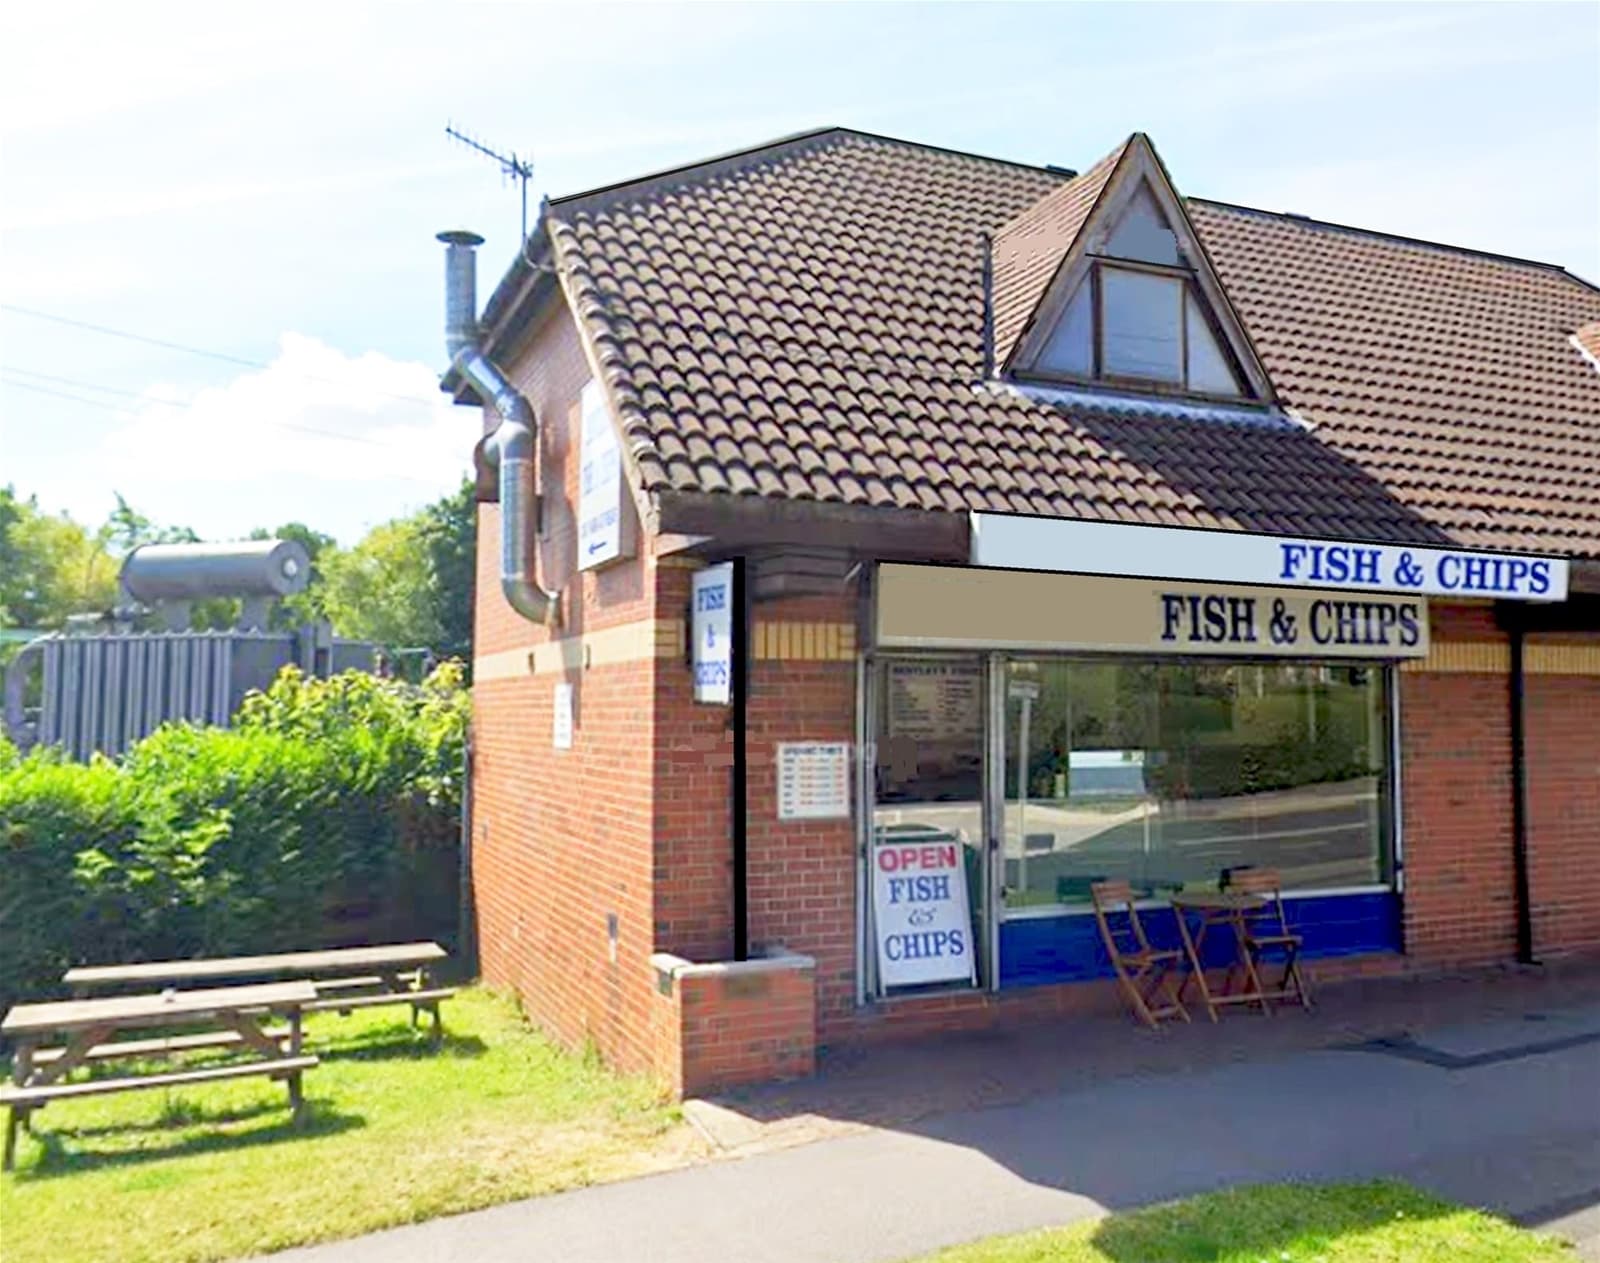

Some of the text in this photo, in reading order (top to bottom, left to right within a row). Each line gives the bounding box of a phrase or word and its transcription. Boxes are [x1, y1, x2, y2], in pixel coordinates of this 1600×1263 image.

[1280, 543, 1551, 594] FISH & CHIPS
[1160, 594, 1420, 647] FISH & CHIPS
[877, 845, 956, 872] OPEN
[888, 875, 950, 904] FISH
[885, 929, 964, 961] CHIPS
